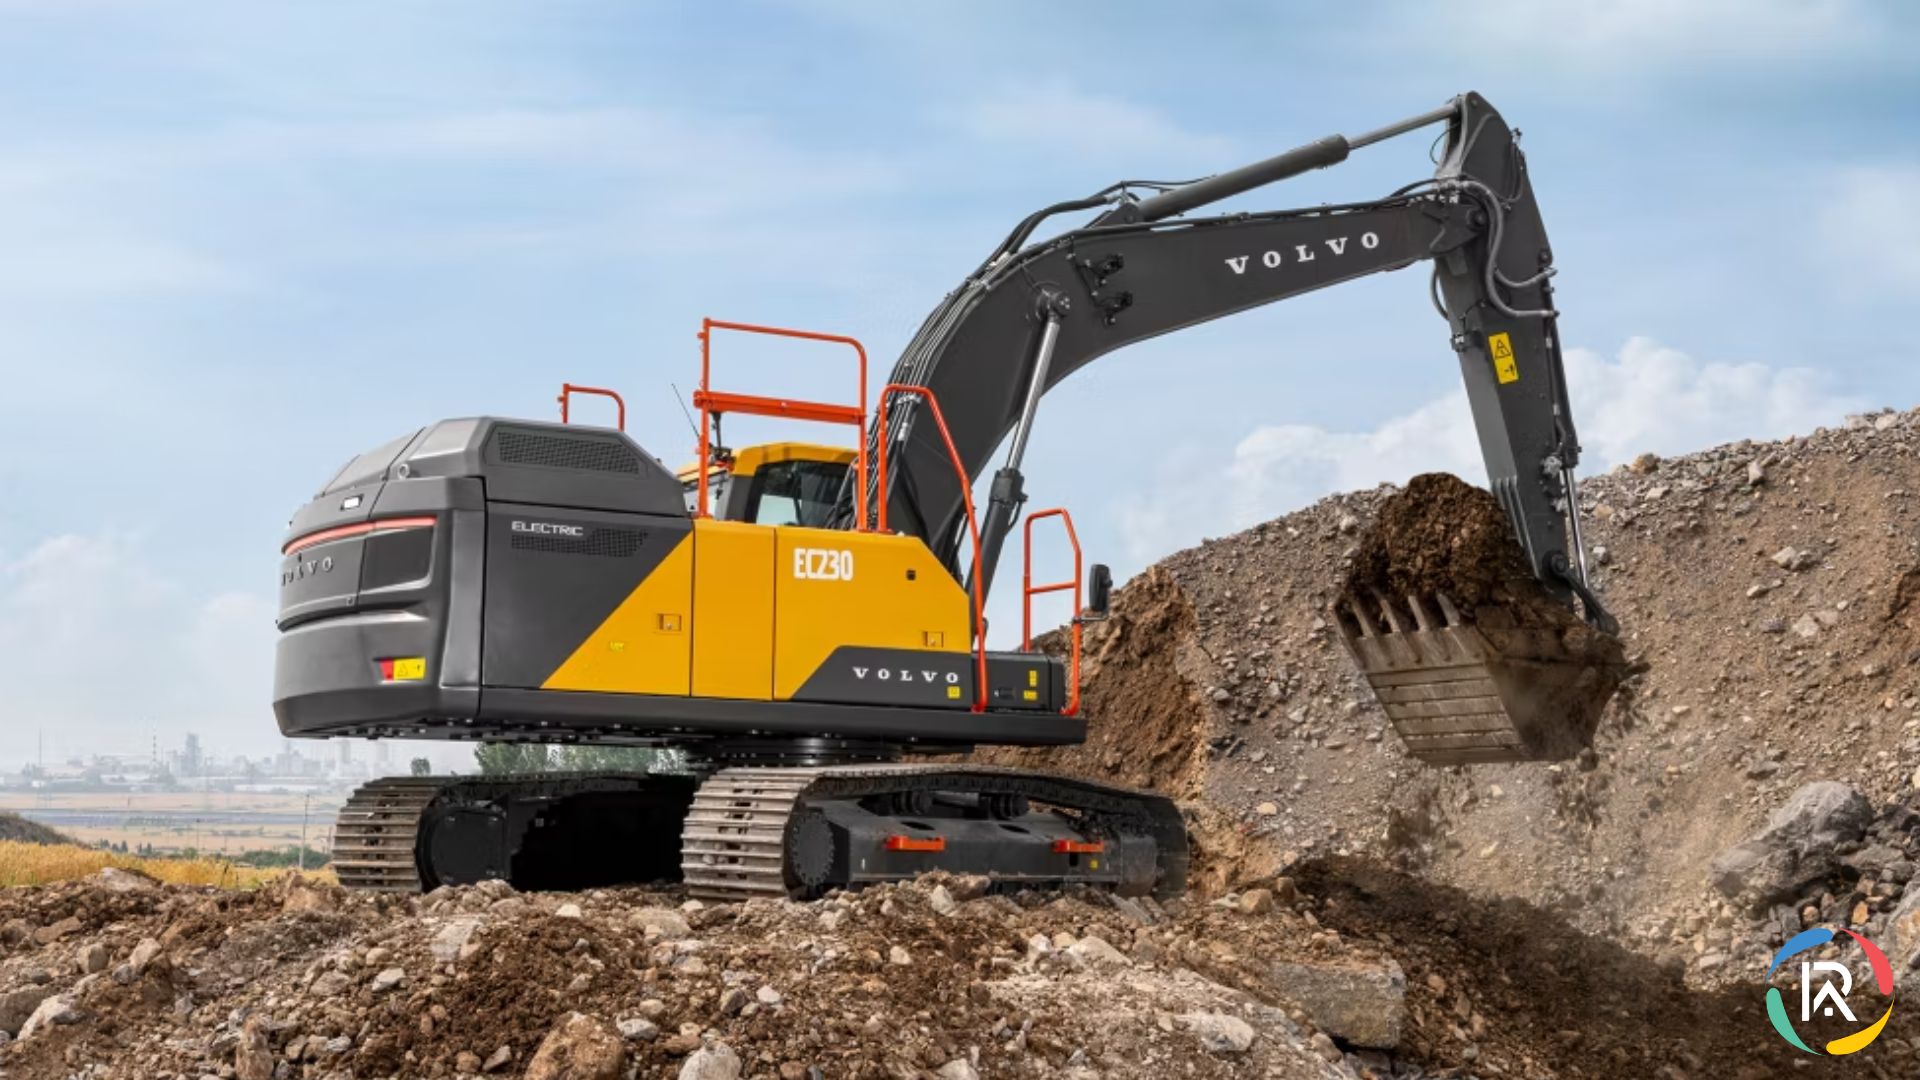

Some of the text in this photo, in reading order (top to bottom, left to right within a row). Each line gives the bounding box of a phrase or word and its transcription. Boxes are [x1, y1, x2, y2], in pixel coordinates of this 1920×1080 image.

[1225, 232, 1379, 275] VOLVO
[511, 520, 584, 536] ELECTRIC
[794, 548, 854, 581] EC230
[853, 666, 959, 684] VOLVO
